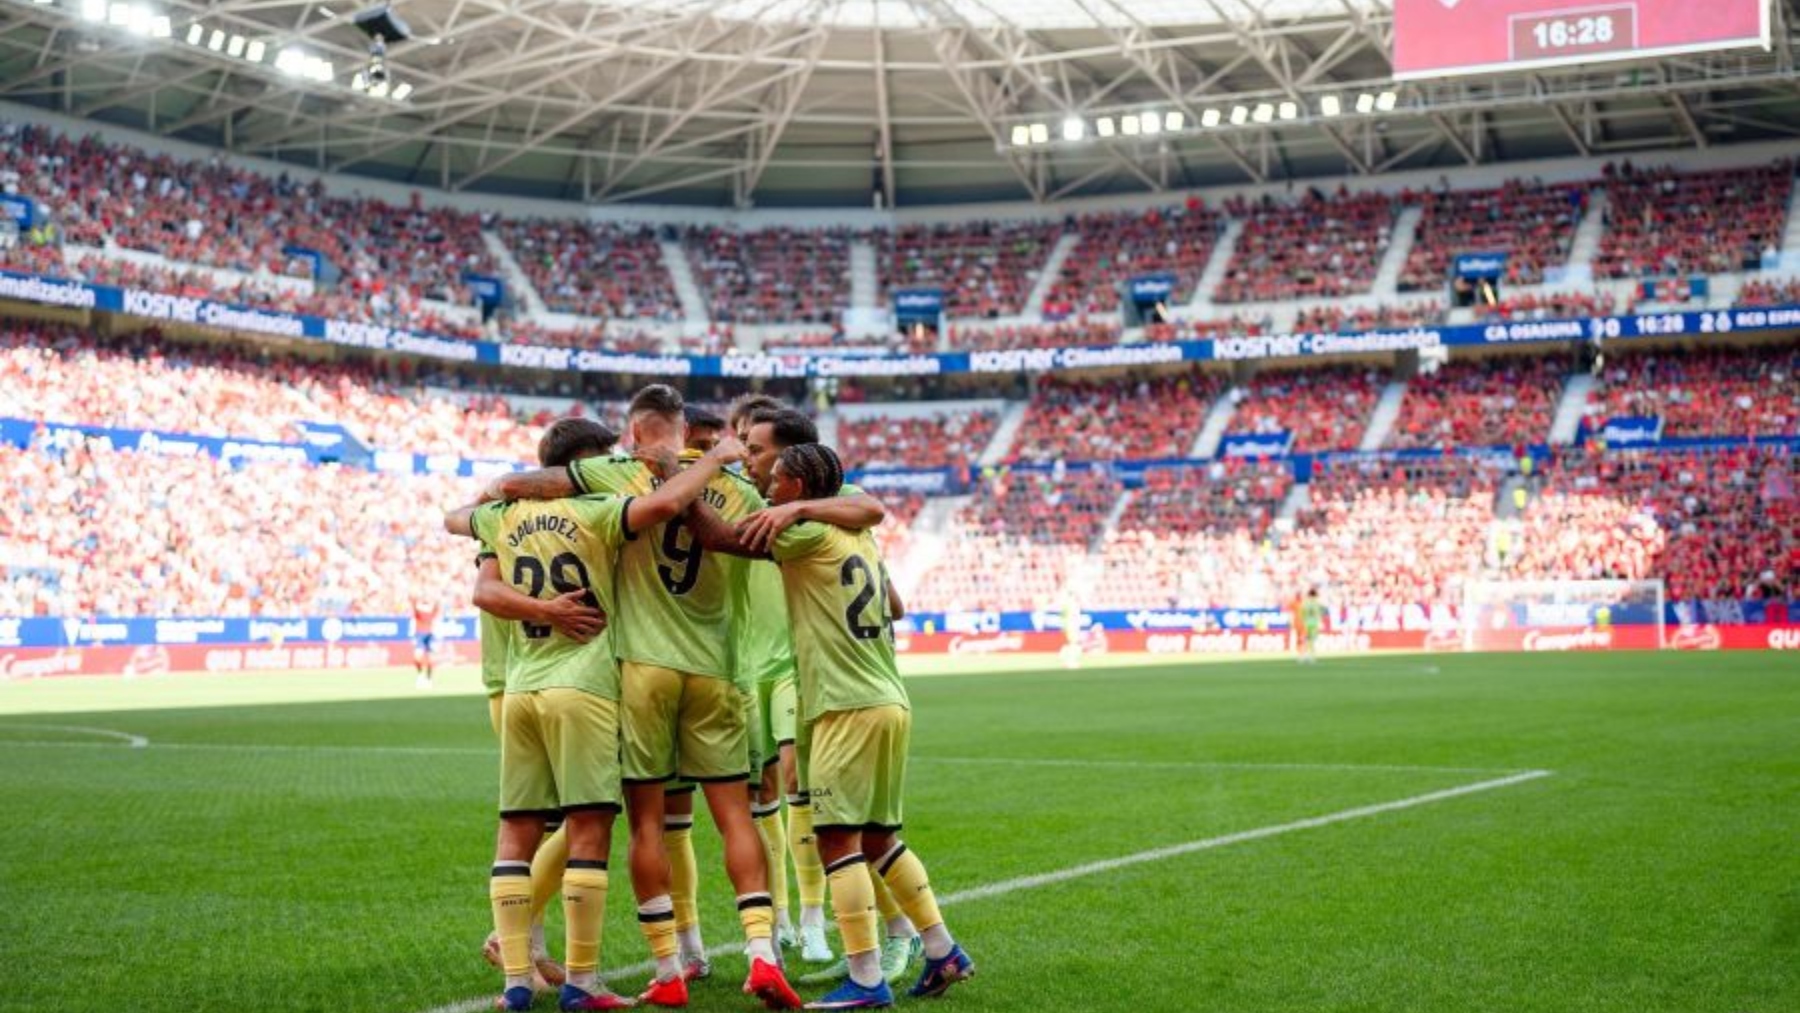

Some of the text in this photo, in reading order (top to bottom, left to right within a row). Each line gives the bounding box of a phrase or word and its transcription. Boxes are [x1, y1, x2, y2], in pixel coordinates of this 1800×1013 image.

[1533, 16, 1614, 48] 16:28
[1510, 321, 1583, 340] OSASUNA
[1635, 313, 1684, 333] 16:28
[657, 515, 702, 595] 9
